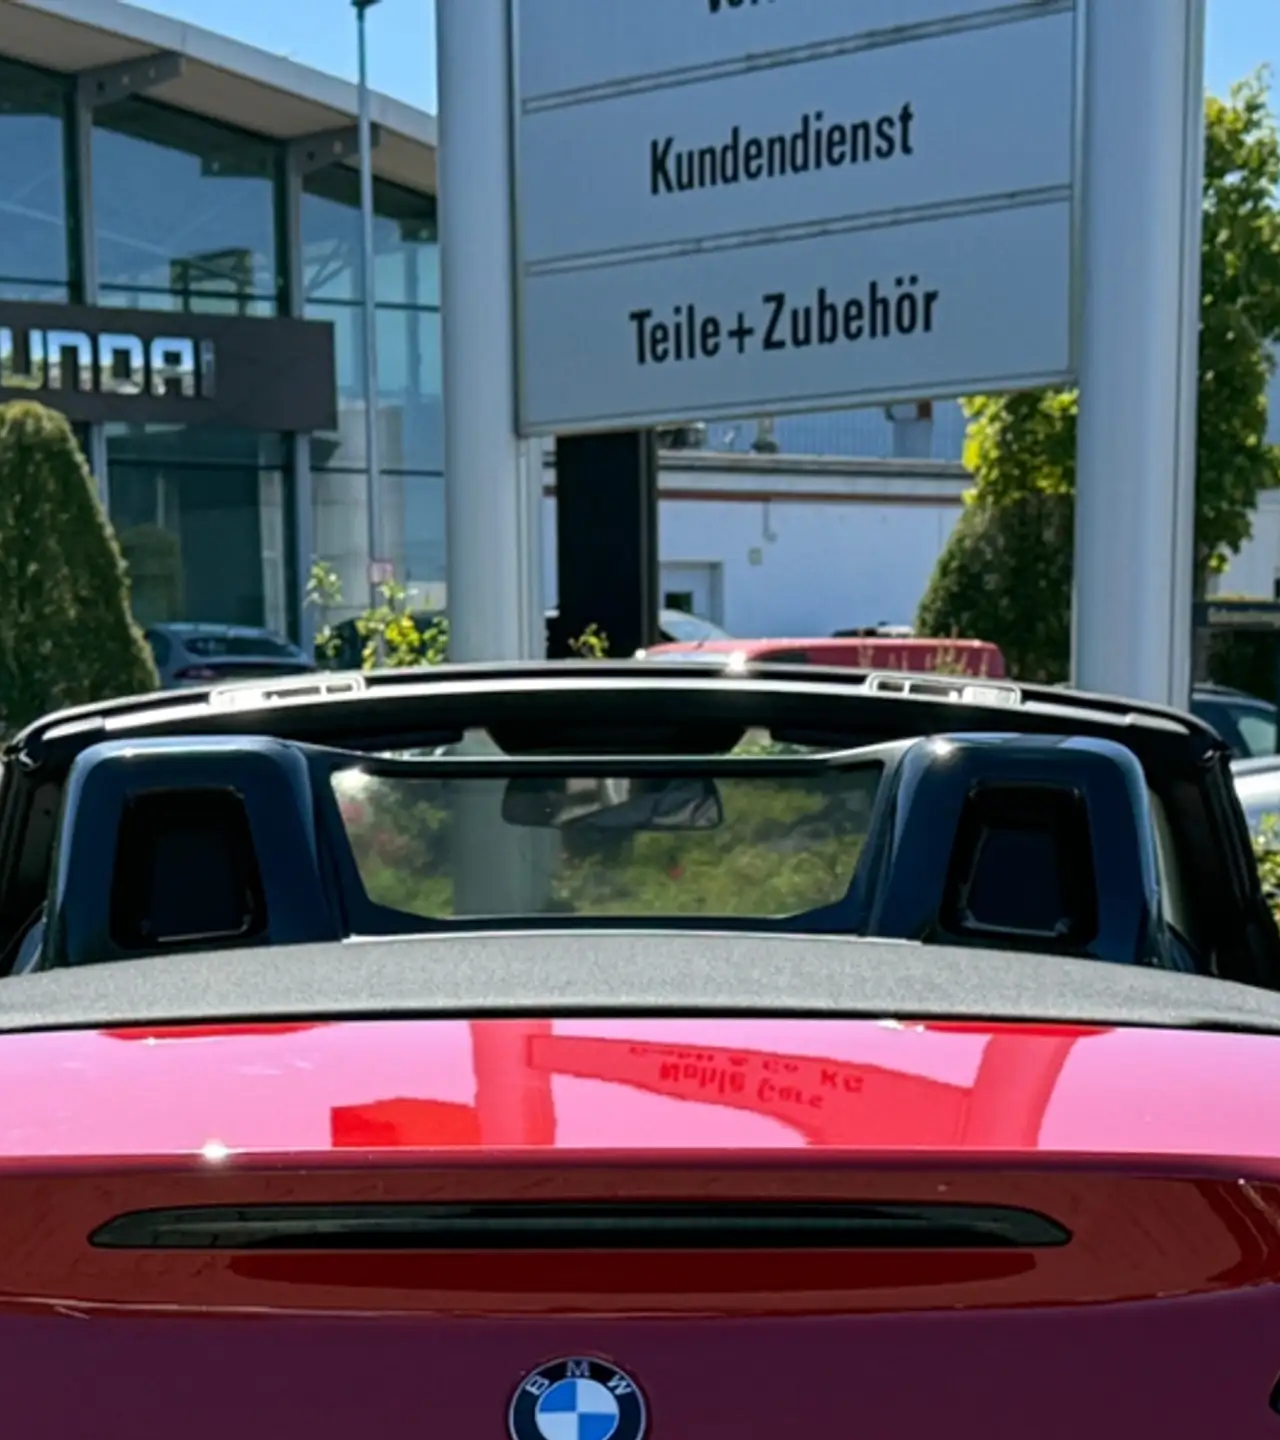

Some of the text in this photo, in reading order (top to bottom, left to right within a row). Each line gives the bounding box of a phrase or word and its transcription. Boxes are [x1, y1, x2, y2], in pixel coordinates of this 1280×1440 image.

[650, 102, 914, 196] Kundendienst
[629, 274, 939, 366] Teile+Zubehör
[524, 1360, 632, 1396] BMW
